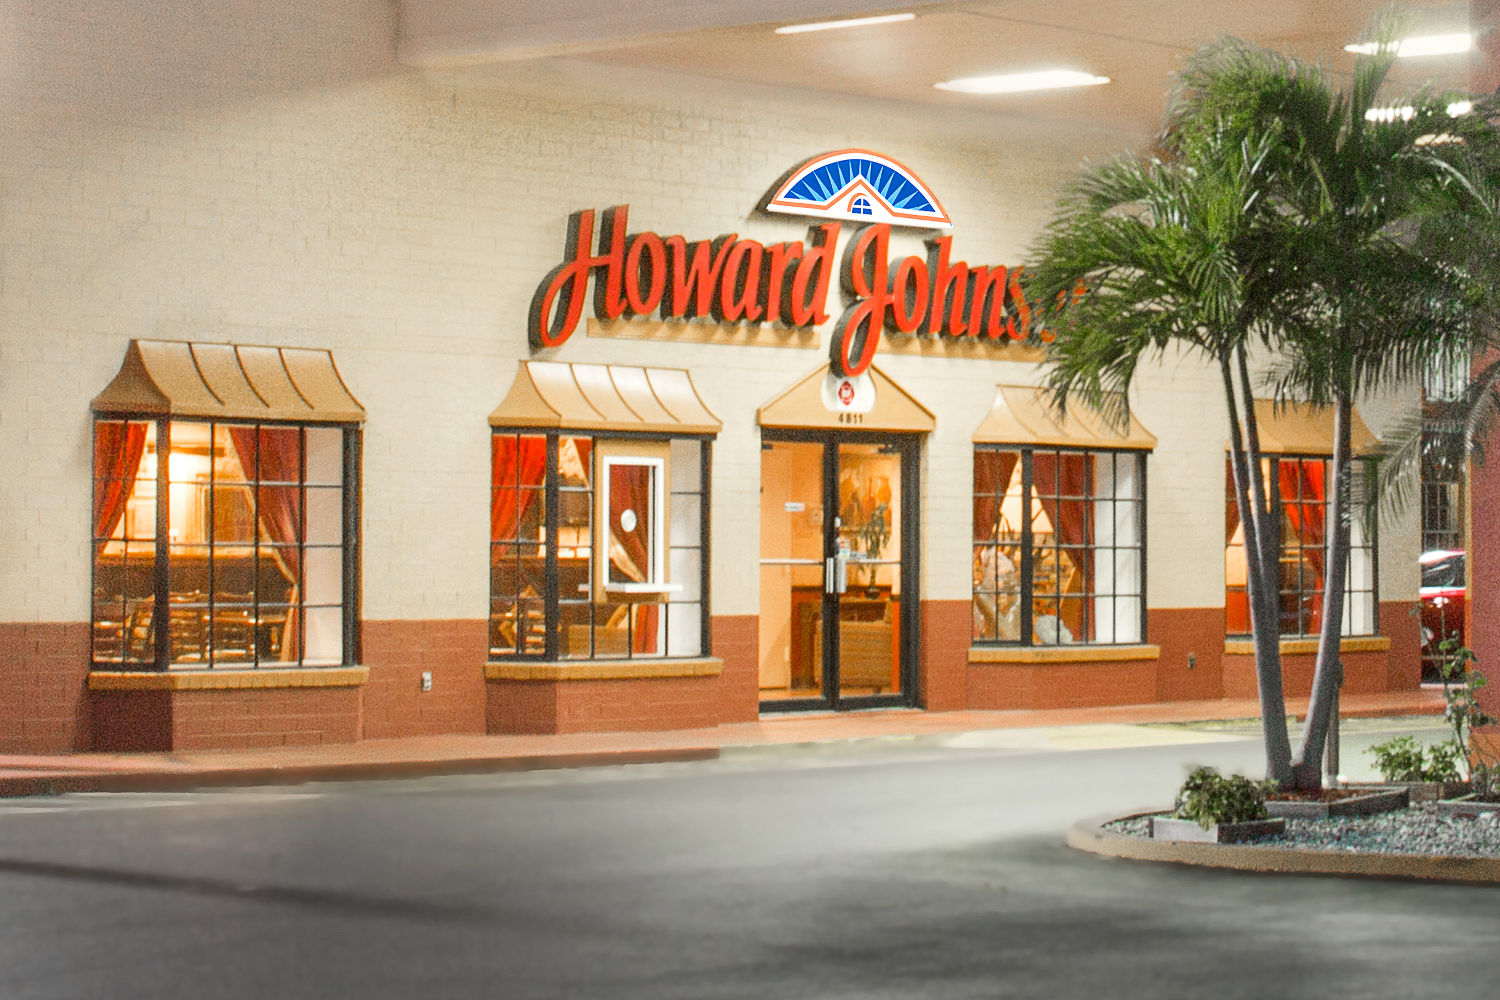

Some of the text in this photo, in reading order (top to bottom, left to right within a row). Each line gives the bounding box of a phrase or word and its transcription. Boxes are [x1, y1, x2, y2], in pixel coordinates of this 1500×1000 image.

[532, 204, 1090, 378] Howard Johns
[838, 412, 863, 424] 4811
